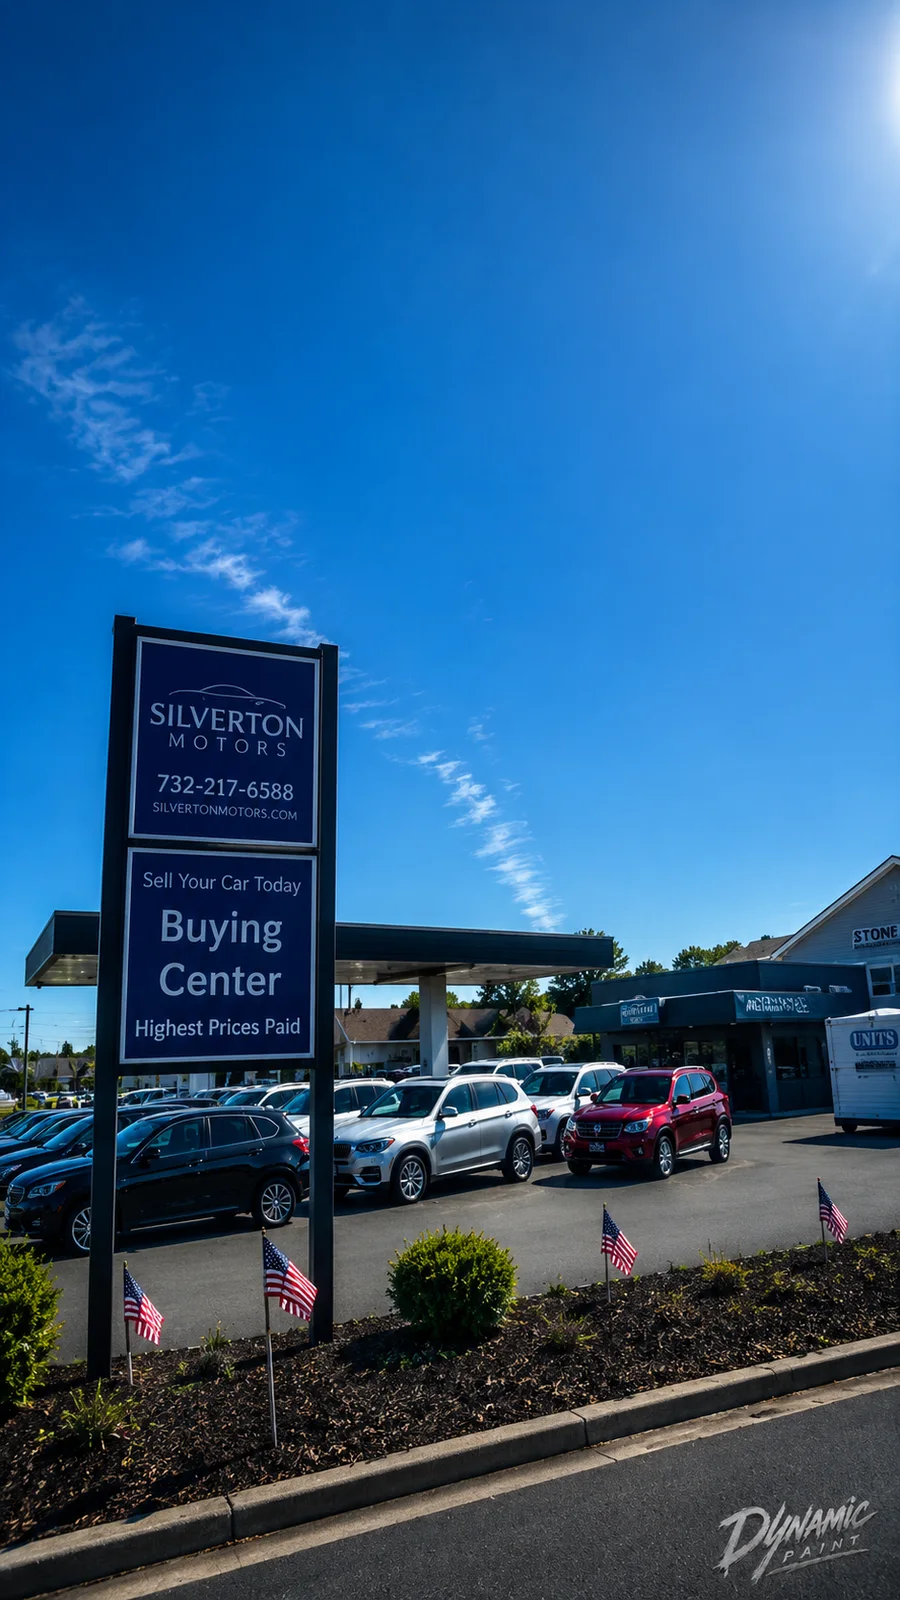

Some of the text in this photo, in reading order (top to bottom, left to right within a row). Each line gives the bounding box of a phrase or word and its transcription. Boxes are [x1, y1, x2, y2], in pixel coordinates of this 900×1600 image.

[150, 702, 304, 739] SILVERTON
[168, 733, 286, 757] MOTORS
[157, 774, 294, 801] 732-217-6588
[153, 802, 298, 821] SILVERTONMOTORS.COM
[143, 872, 301, 897] Sell Your Car Today
[161, 909, 283, 953] Buying
[853, 925, 898, 943] STONE
[159, 962, 282, 997] Center
[135, 1017, 301, 1042] Highest Prices Paid
[853, 1031, 895, 1046] UNITS
